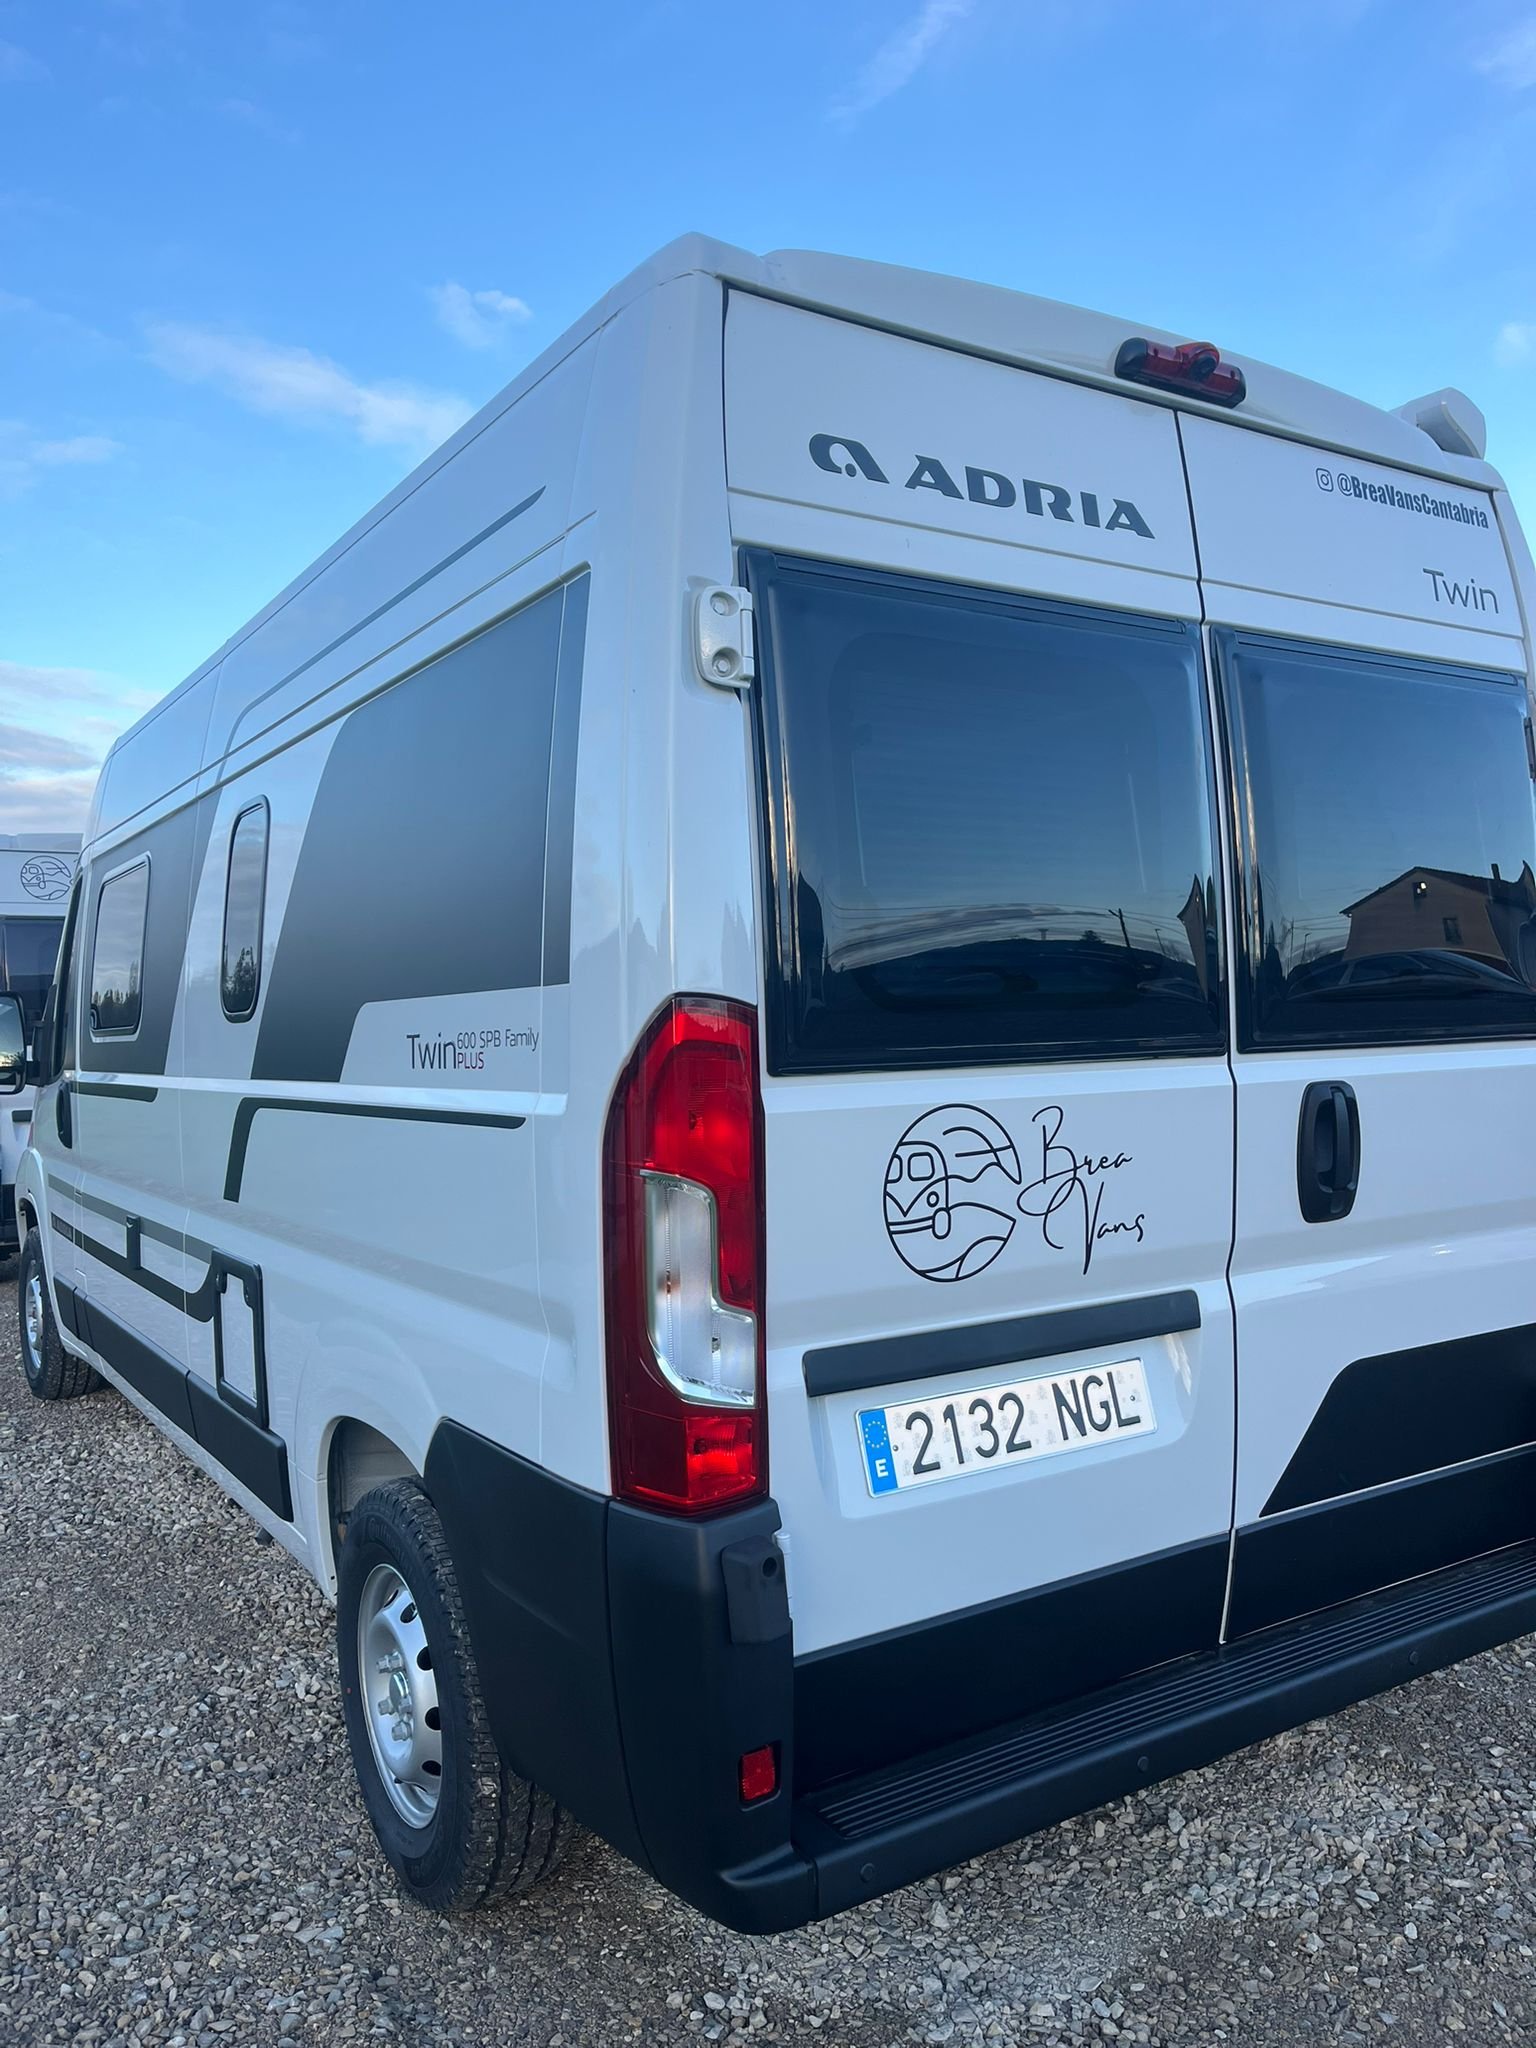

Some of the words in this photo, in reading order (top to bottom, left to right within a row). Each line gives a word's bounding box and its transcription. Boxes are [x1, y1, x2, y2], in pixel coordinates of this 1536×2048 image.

[904, 454, 1156, 540] ADRIA
[1336, 472, 1489, 529] @BreaVansCantabria
[1422, 567, 1499, 614] Twin
[406, 1031, 456, 1070] Twin
[456, 1031, 477, 1050] 600
[479, 1029, 501, 1048] SPB
[504, 1027, 539, 1052] Family
[457, 1051, 485, 1070] PLUS
[1017, 1105, 1133, 1217] Brea
[905, 1392, 1032, 1475] 2132
[1051, 1371, 1141, 1441] NGL
[875, 1458, 889, 1478] E
